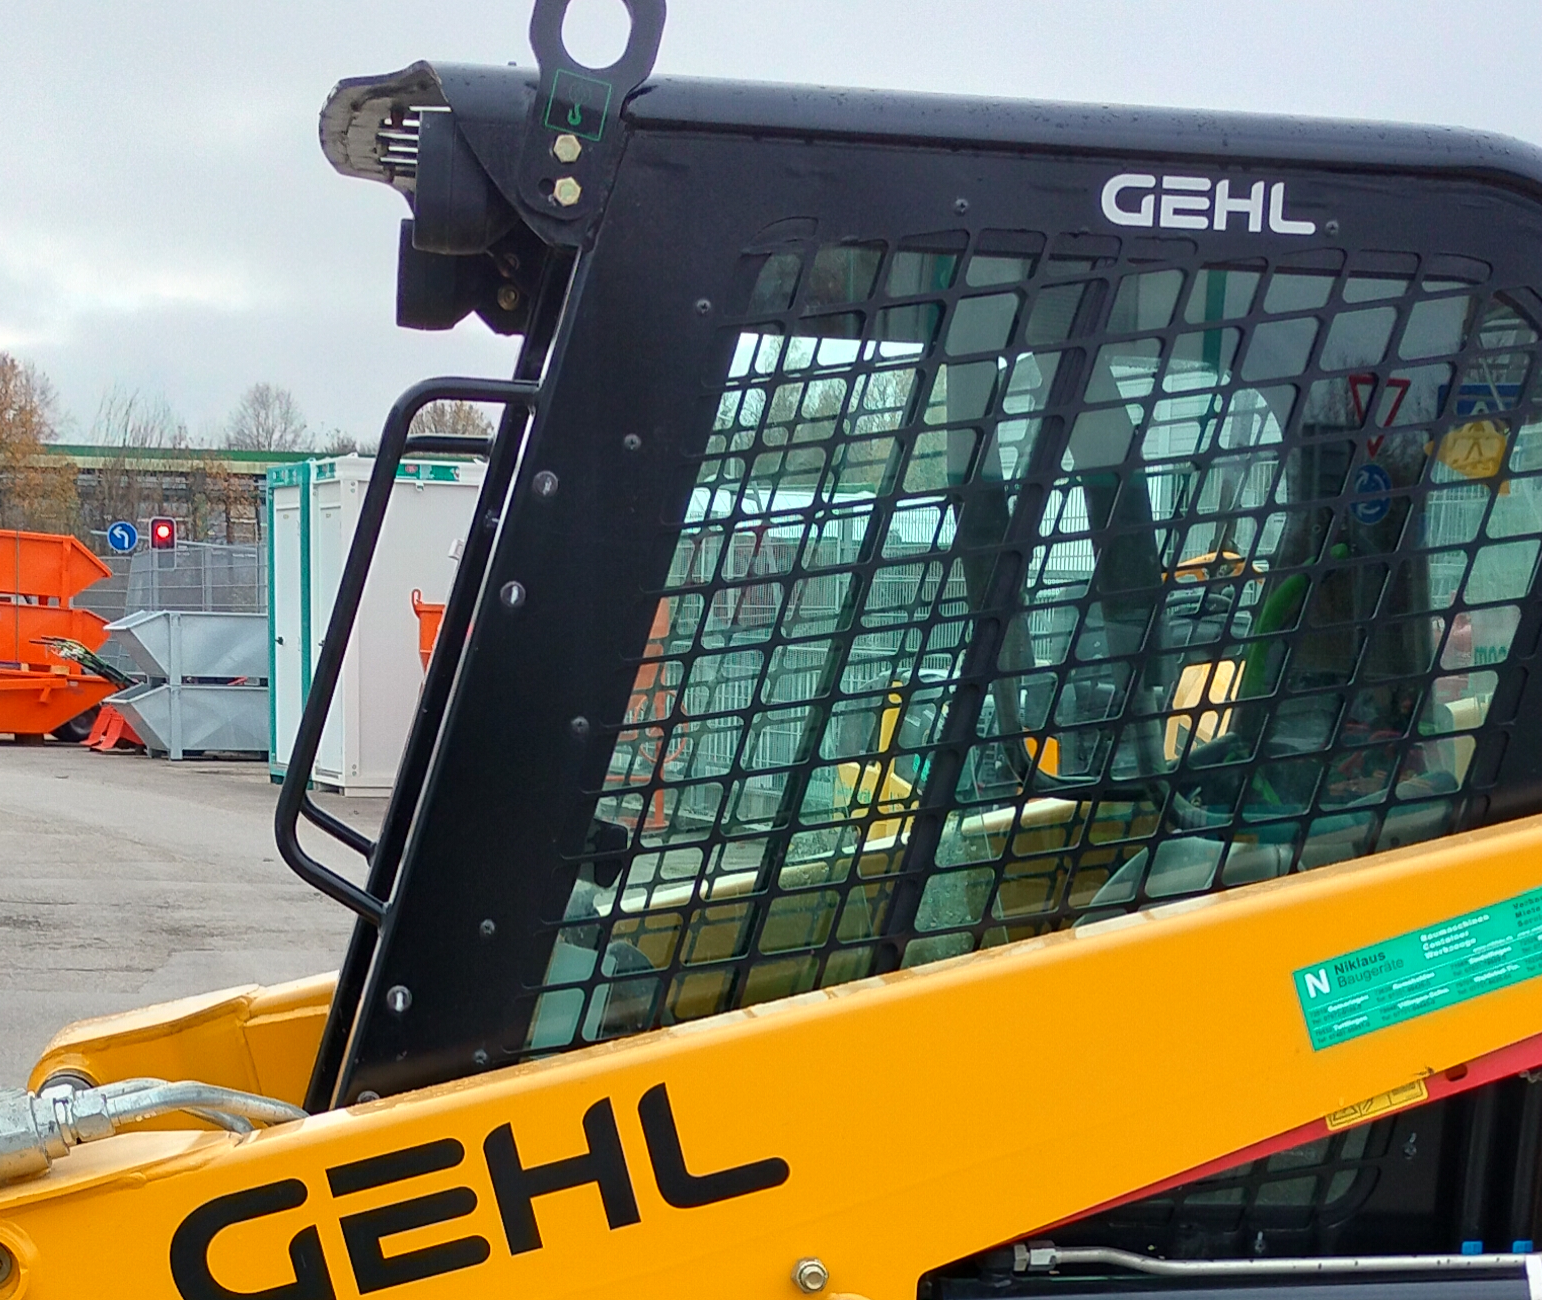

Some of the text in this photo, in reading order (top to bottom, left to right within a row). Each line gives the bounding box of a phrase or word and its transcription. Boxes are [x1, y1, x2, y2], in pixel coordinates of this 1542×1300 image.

[1101, 173, 1316, 236] GEHL
[1303, 951, 1387, 999] N Niklaus
[1336, 958, 1405, 988] Baugeräte
